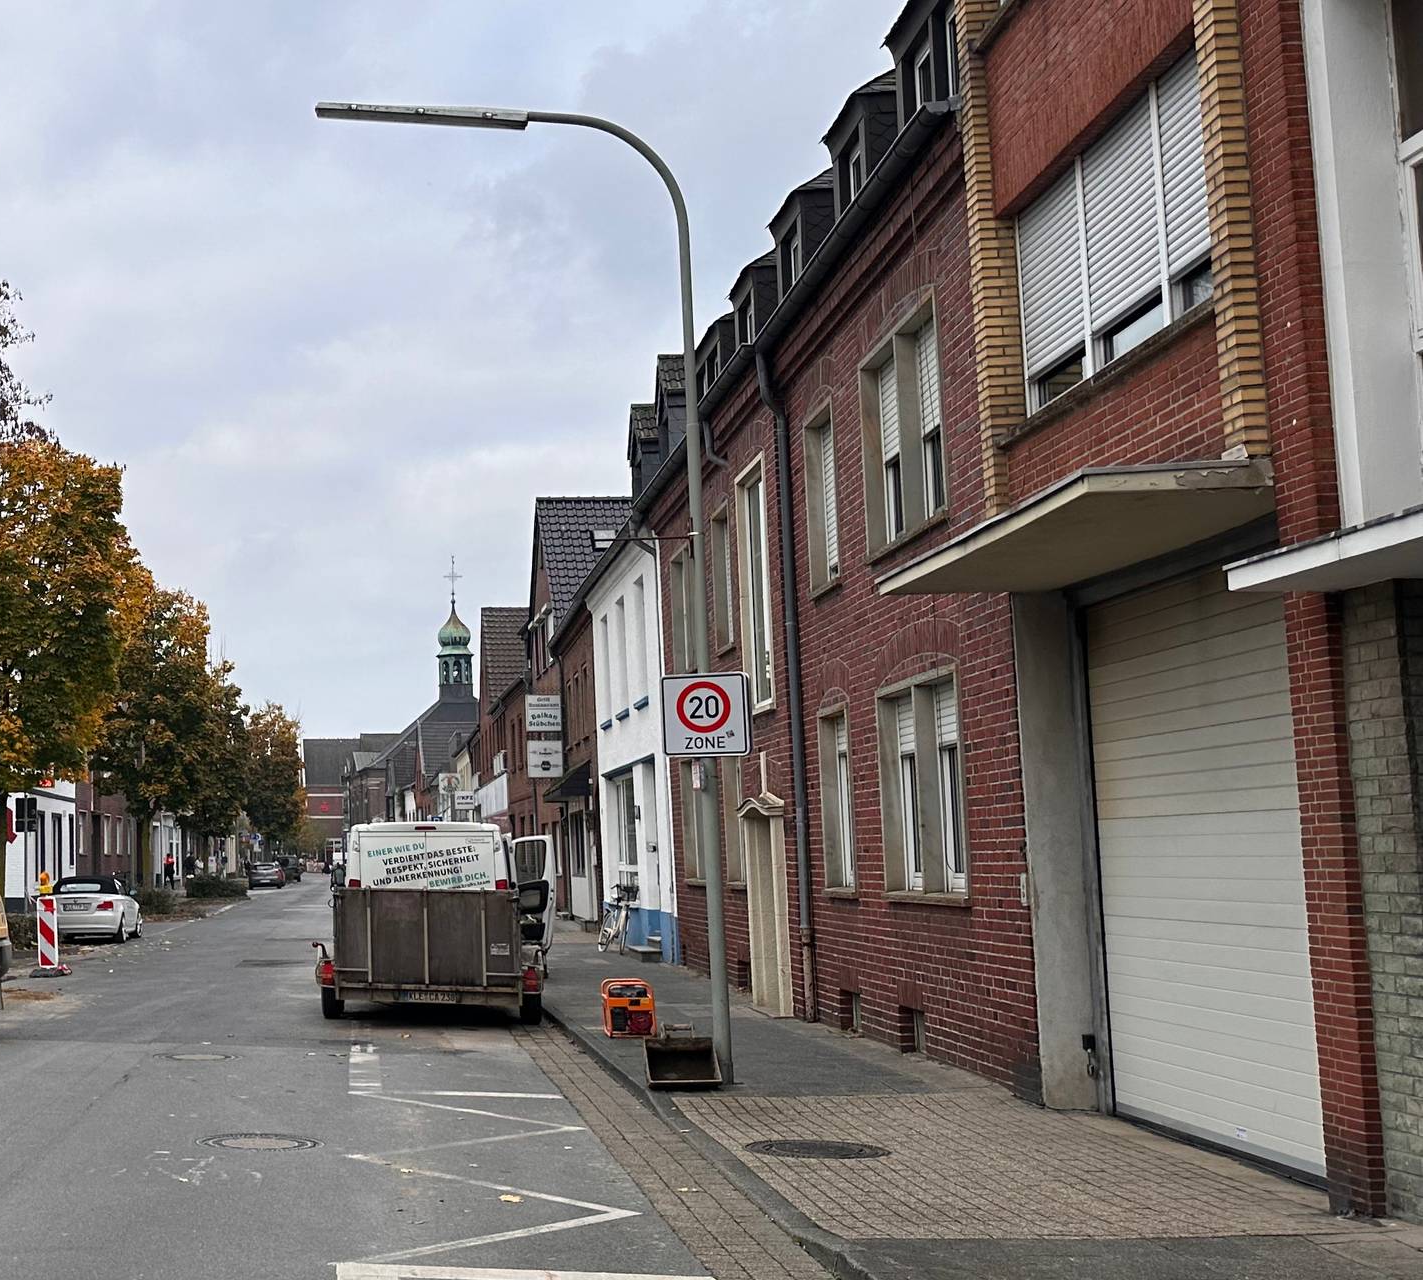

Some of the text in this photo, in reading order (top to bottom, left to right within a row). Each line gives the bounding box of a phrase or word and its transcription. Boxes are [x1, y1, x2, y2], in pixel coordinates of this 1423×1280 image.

[689, 695, 719, 719] 20
[531, 712, 558, 720] Balkan
[685, 736, 726, 750] ZONE
[367, 842, 425, 858] EINER WIE DU
[382, 852, 425, 866] VERDIENT
[427, 850, 445, 860] DAS
[385, 853, 480, 876] RESPEKT, SICHERHEIT
[372, 866, 463, 887] UND ANERKENNUNG!
[428, 875, 463, 888] BEWIRB
